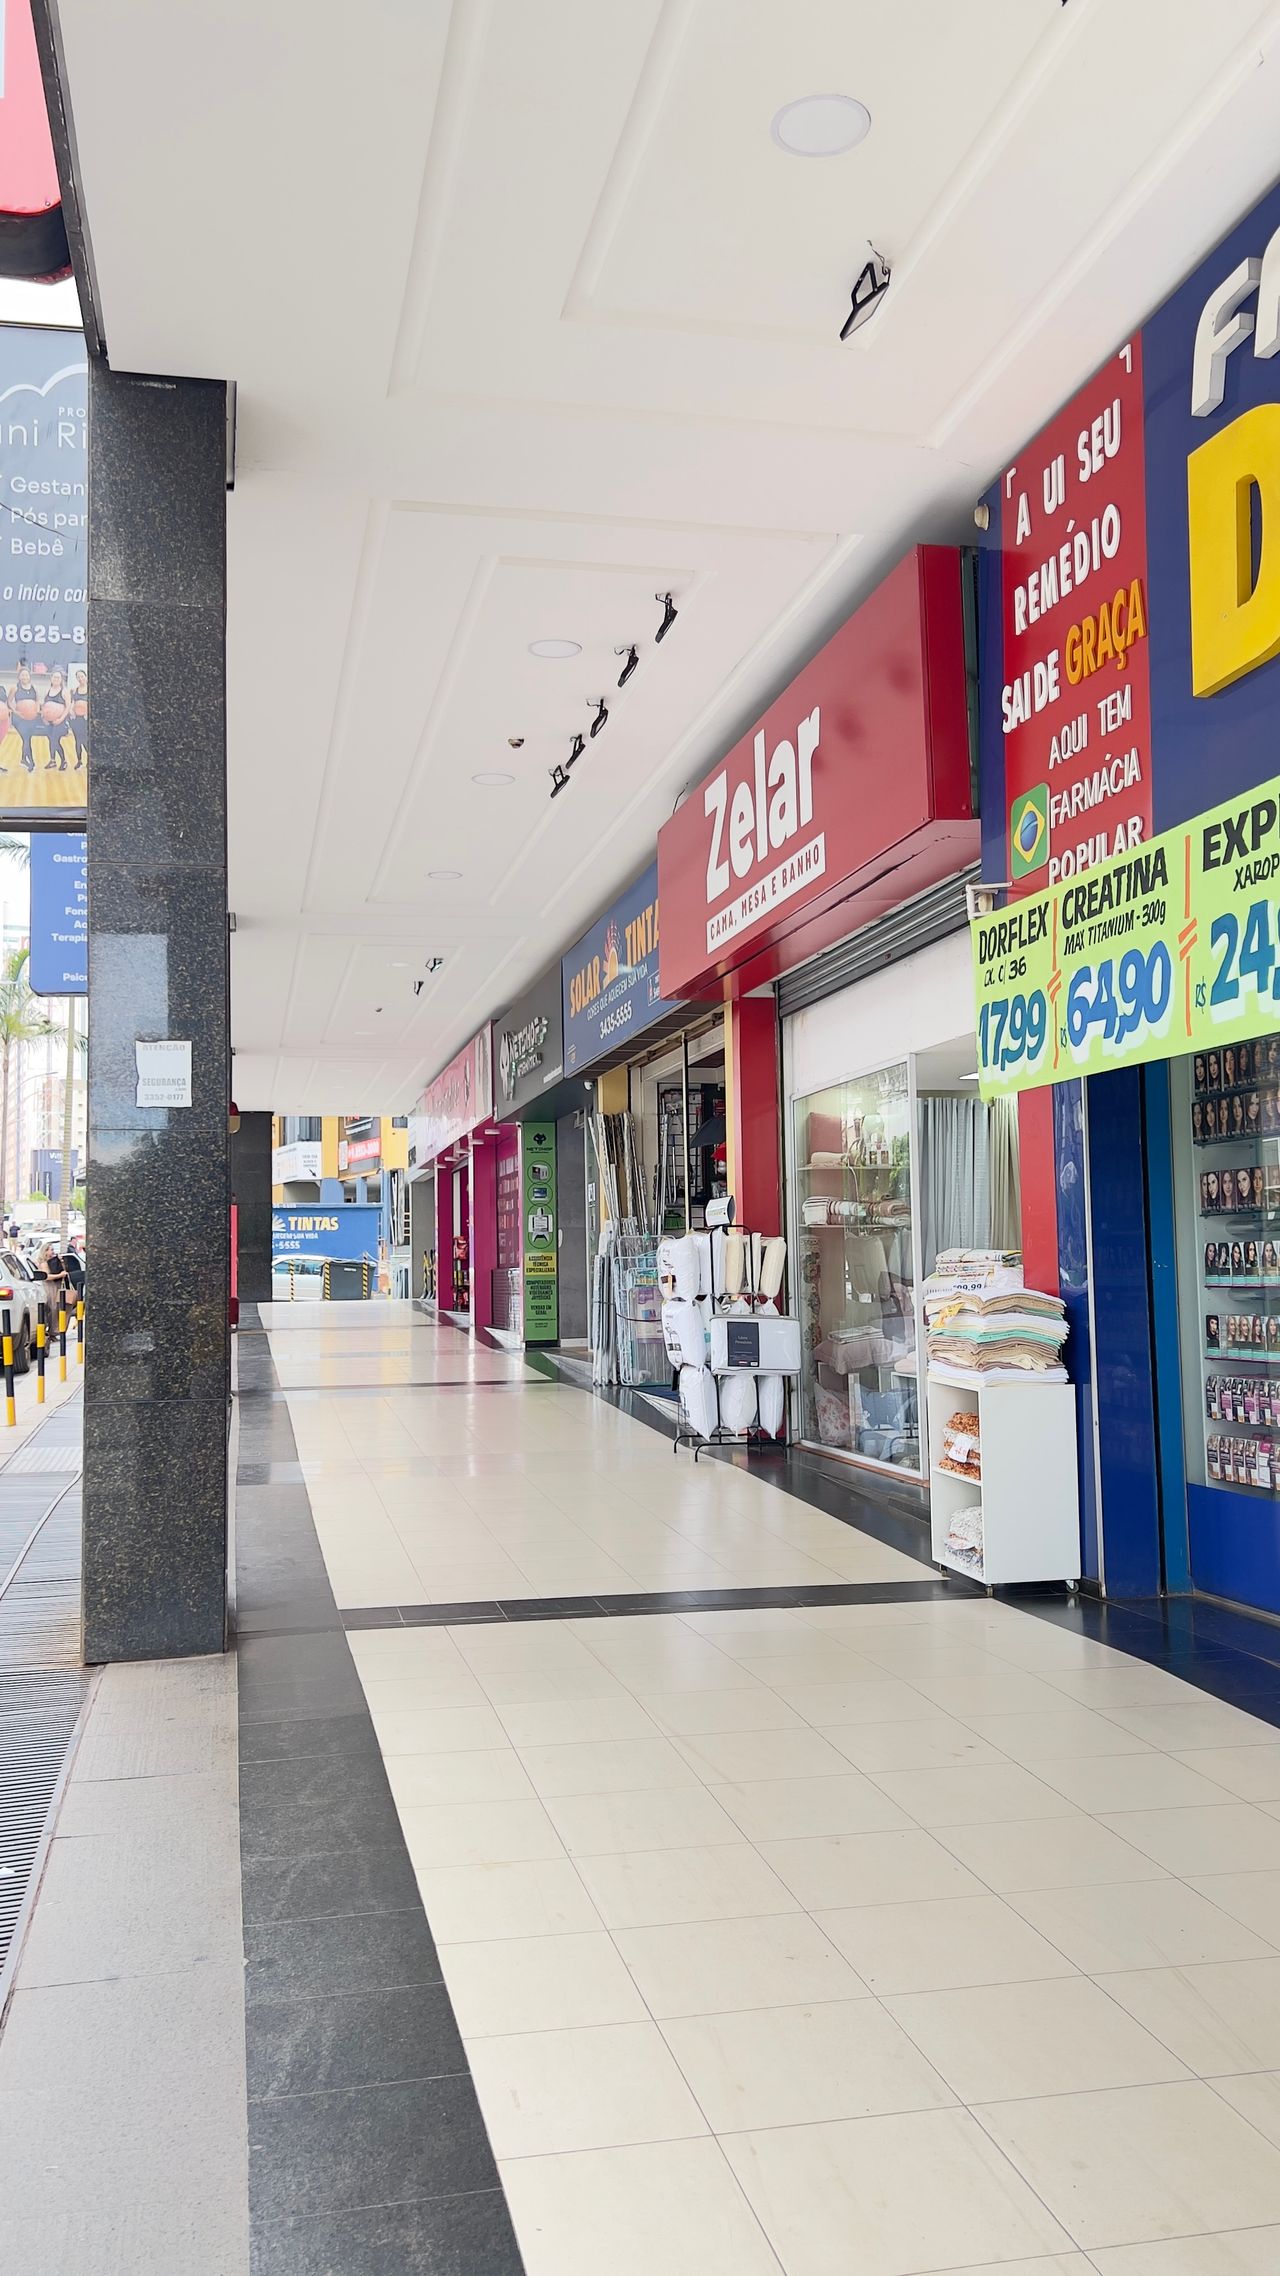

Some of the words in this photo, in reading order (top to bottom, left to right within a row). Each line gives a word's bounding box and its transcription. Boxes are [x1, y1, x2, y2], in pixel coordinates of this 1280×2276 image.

[0, 419, 38, 446] ni
[1077, 398, 1121, 483] SEU
[10, 476, 88, 497] Gestan
[11, 507, 48, 526] Pós
[11, 538, 64, 557] Bebê
[1014, 503, 1121, 636] REMÉDIO
[3, 586, 13, 601] o
[18, 583, 60, 602] início
[0, 623, 86, 645] 8625-8
[1002, 671, 1032, 734] SAI
[1034, 649, 1060, 713] DE
[1065, 578, 1147, 686] GRAÇA
[1048, 713, 1088, 770] AQUI
[1097, 684, 1132, 737] TEM
[704, 705, 820, 904] Zelar
[1049, 747, 1142, 829] FARMÁCIA
[1048, 814, 1144, 887] POPULAR
[1203, 793, 1280, 872] EXP
[710, 910, 737, 941] CAMA,
[741, 884, 767, 918] MESA
[771, 875, 777, 896] E
[782, 844, 819, 888] BANHO
[1061, 847, 1169, 930] CREATINA
[979, 901, 1050, 965] DORFLEX
[1064, 929, 1085, 956] MAX
[1088, 910, 1135, 946] TITANIUM
[1142, 898, 1166, 927] 300g
[570, 955, 600, 1019] SOLAR
[636, 962, 649, 982] VIDA
[1008, 955, 1027, 981] 36
[1067, 940, 1172, 1048] 64,90
[599, 999, 633, 1040] 3435-5555
[978, 989, 1047, 1072] 17,99
[288, 1216, 340, 1231] TINTAS
